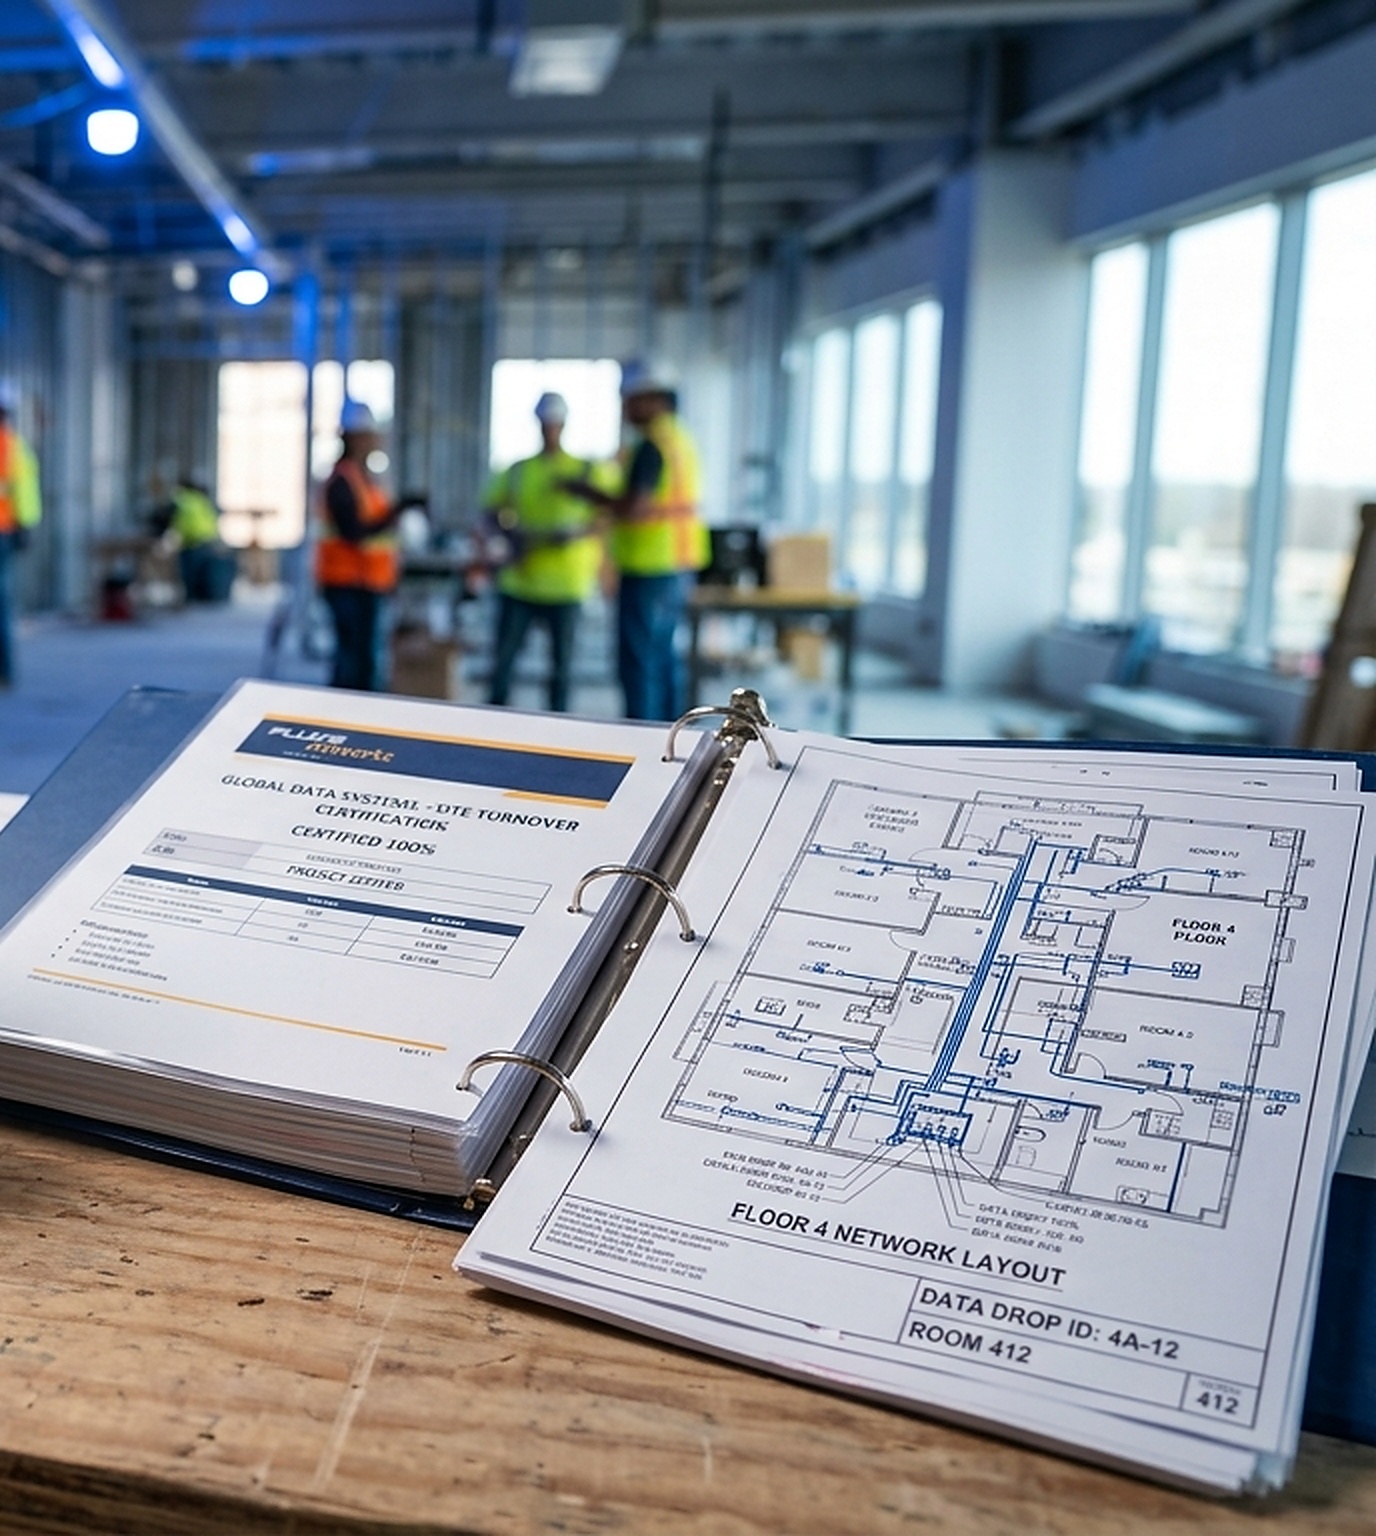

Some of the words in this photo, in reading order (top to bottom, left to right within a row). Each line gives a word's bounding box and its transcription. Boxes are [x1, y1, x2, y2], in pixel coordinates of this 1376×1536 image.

[221, 775, 285, 792] GLOBAL
[290, 784, 336, 799] DATA
[731, 1202, 810, 1233] FLOOR
[814, 1221, 828, 1237] 4
[834, 1225, 957, 1264] NETWORK
[962, 1250, 1066, 1286] LAYOUT
[908, 1322, 982, 1352] ROOM
[989, 1341, 1032, 1364] 412
[920, 1288, 984, 1316] DATA
[991, 1302, 1061, 1331] DROP
[1068, 1320, 1100, 1342] ID:
[1108, 1330, 1180, 1360] 4A-12
[1196, 1392, 1239, 1415] 412
